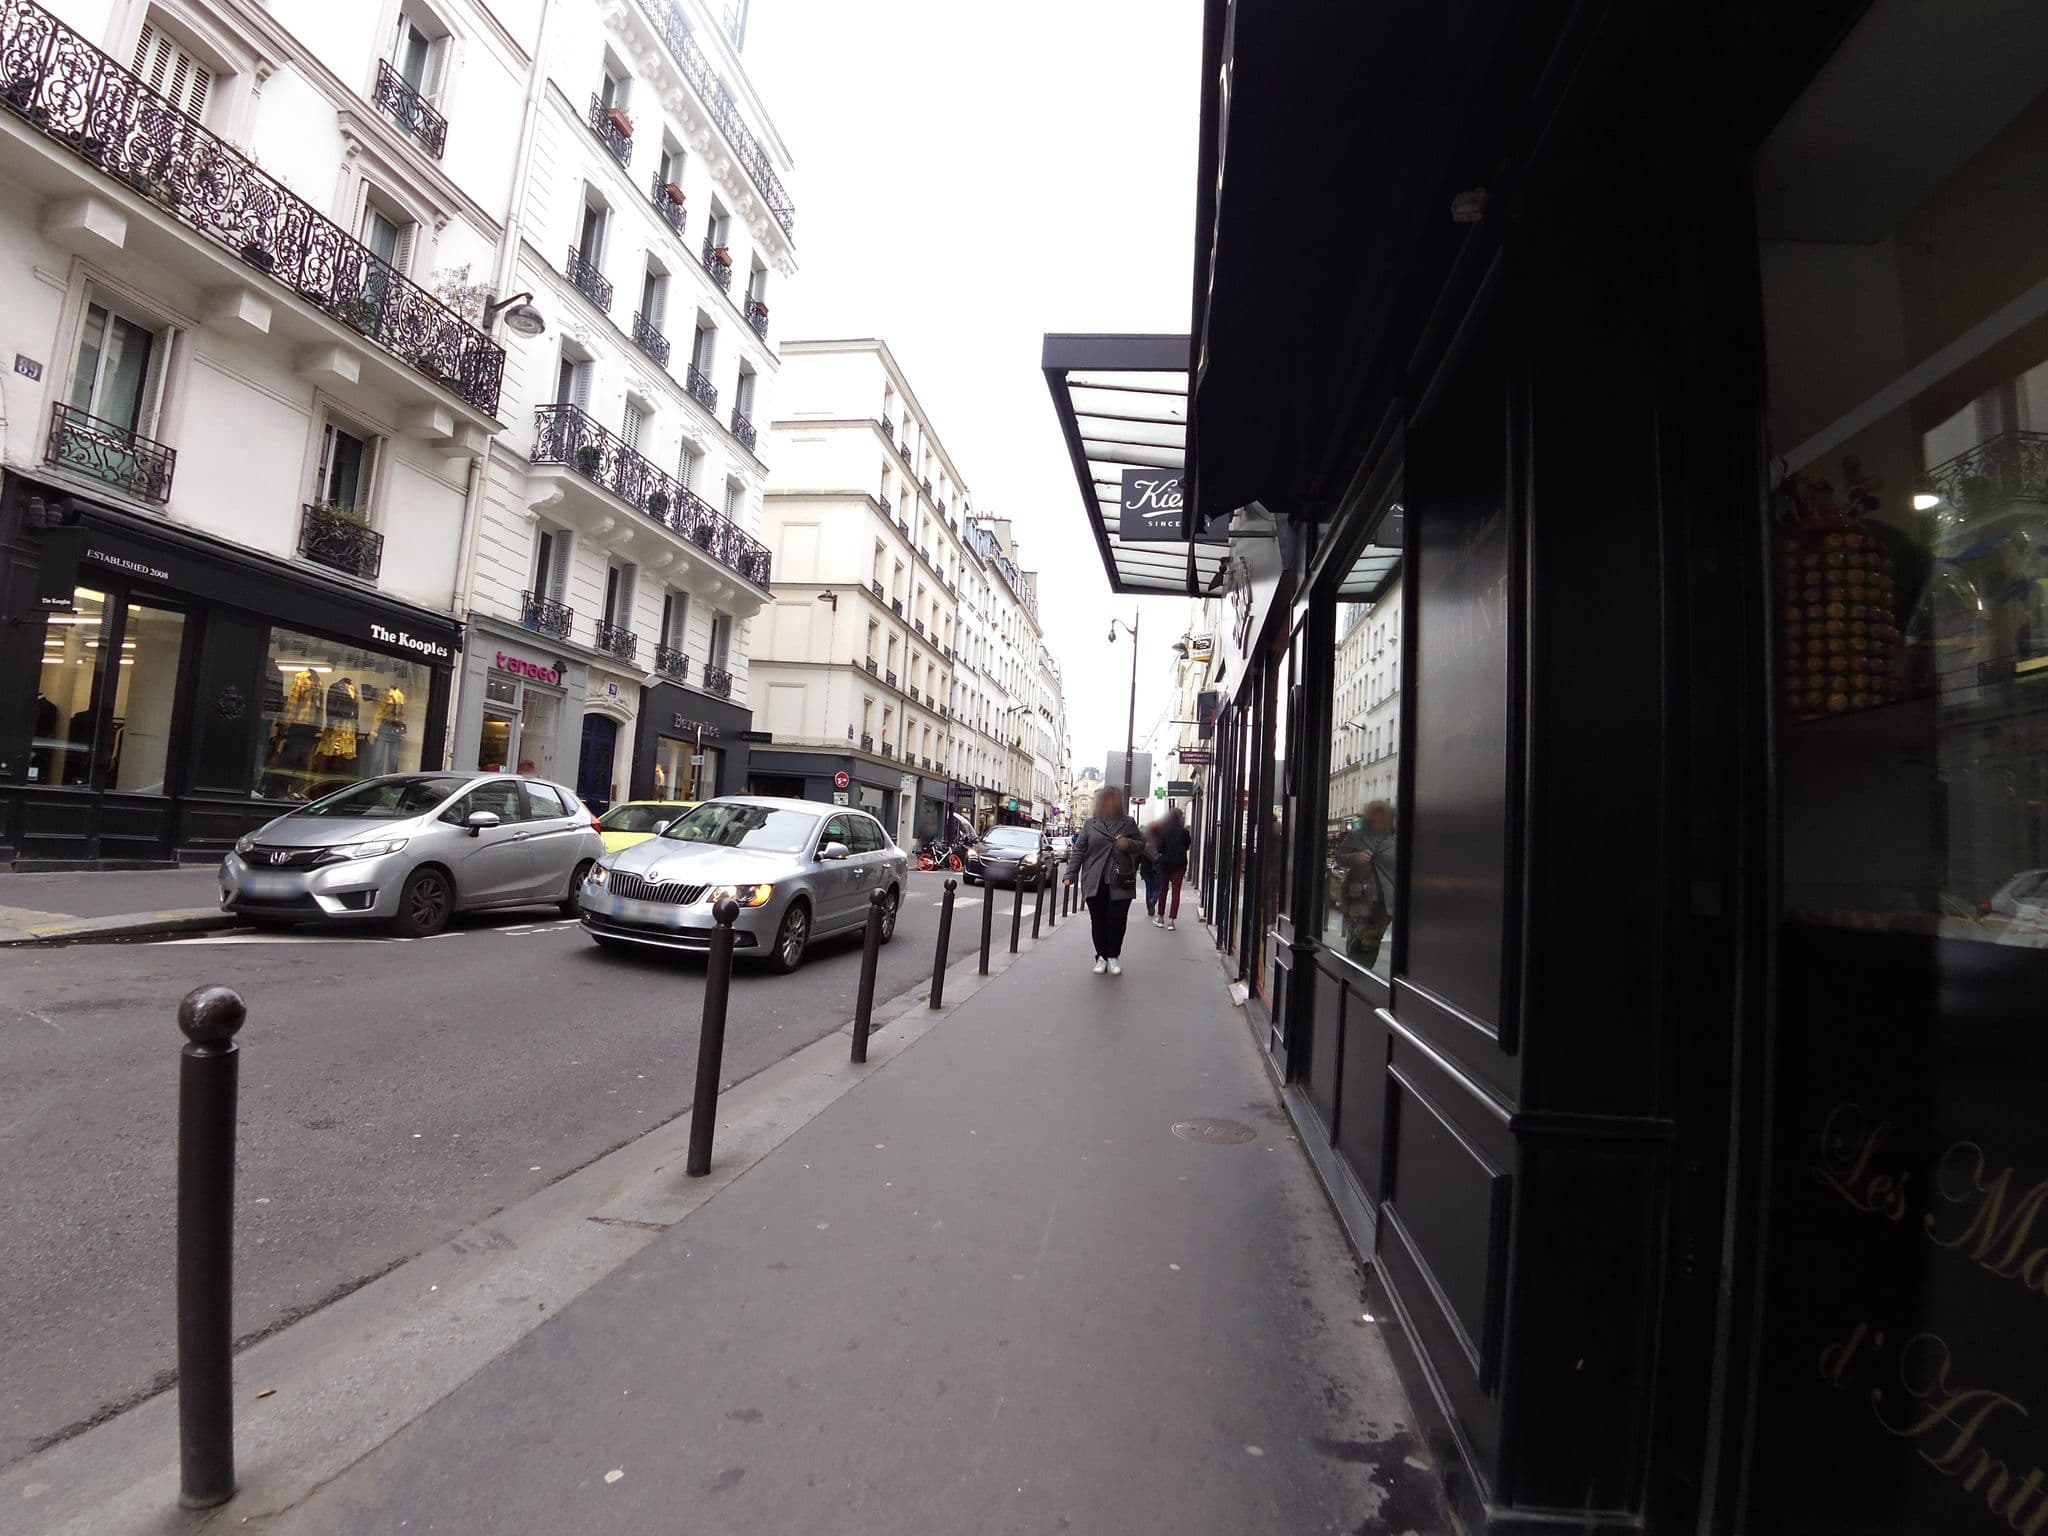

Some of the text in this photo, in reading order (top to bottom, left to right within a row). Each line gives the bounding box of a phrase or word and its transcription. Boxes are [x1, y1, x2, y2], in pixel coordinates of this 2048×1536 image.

[1126, 479, 1183, 509] Kie
[87, 549, 169, 580] ESTABLISHED 2008
[370, 624, 448, 657] The Kooples
[1811, 1101, 1911, 1223] Les
